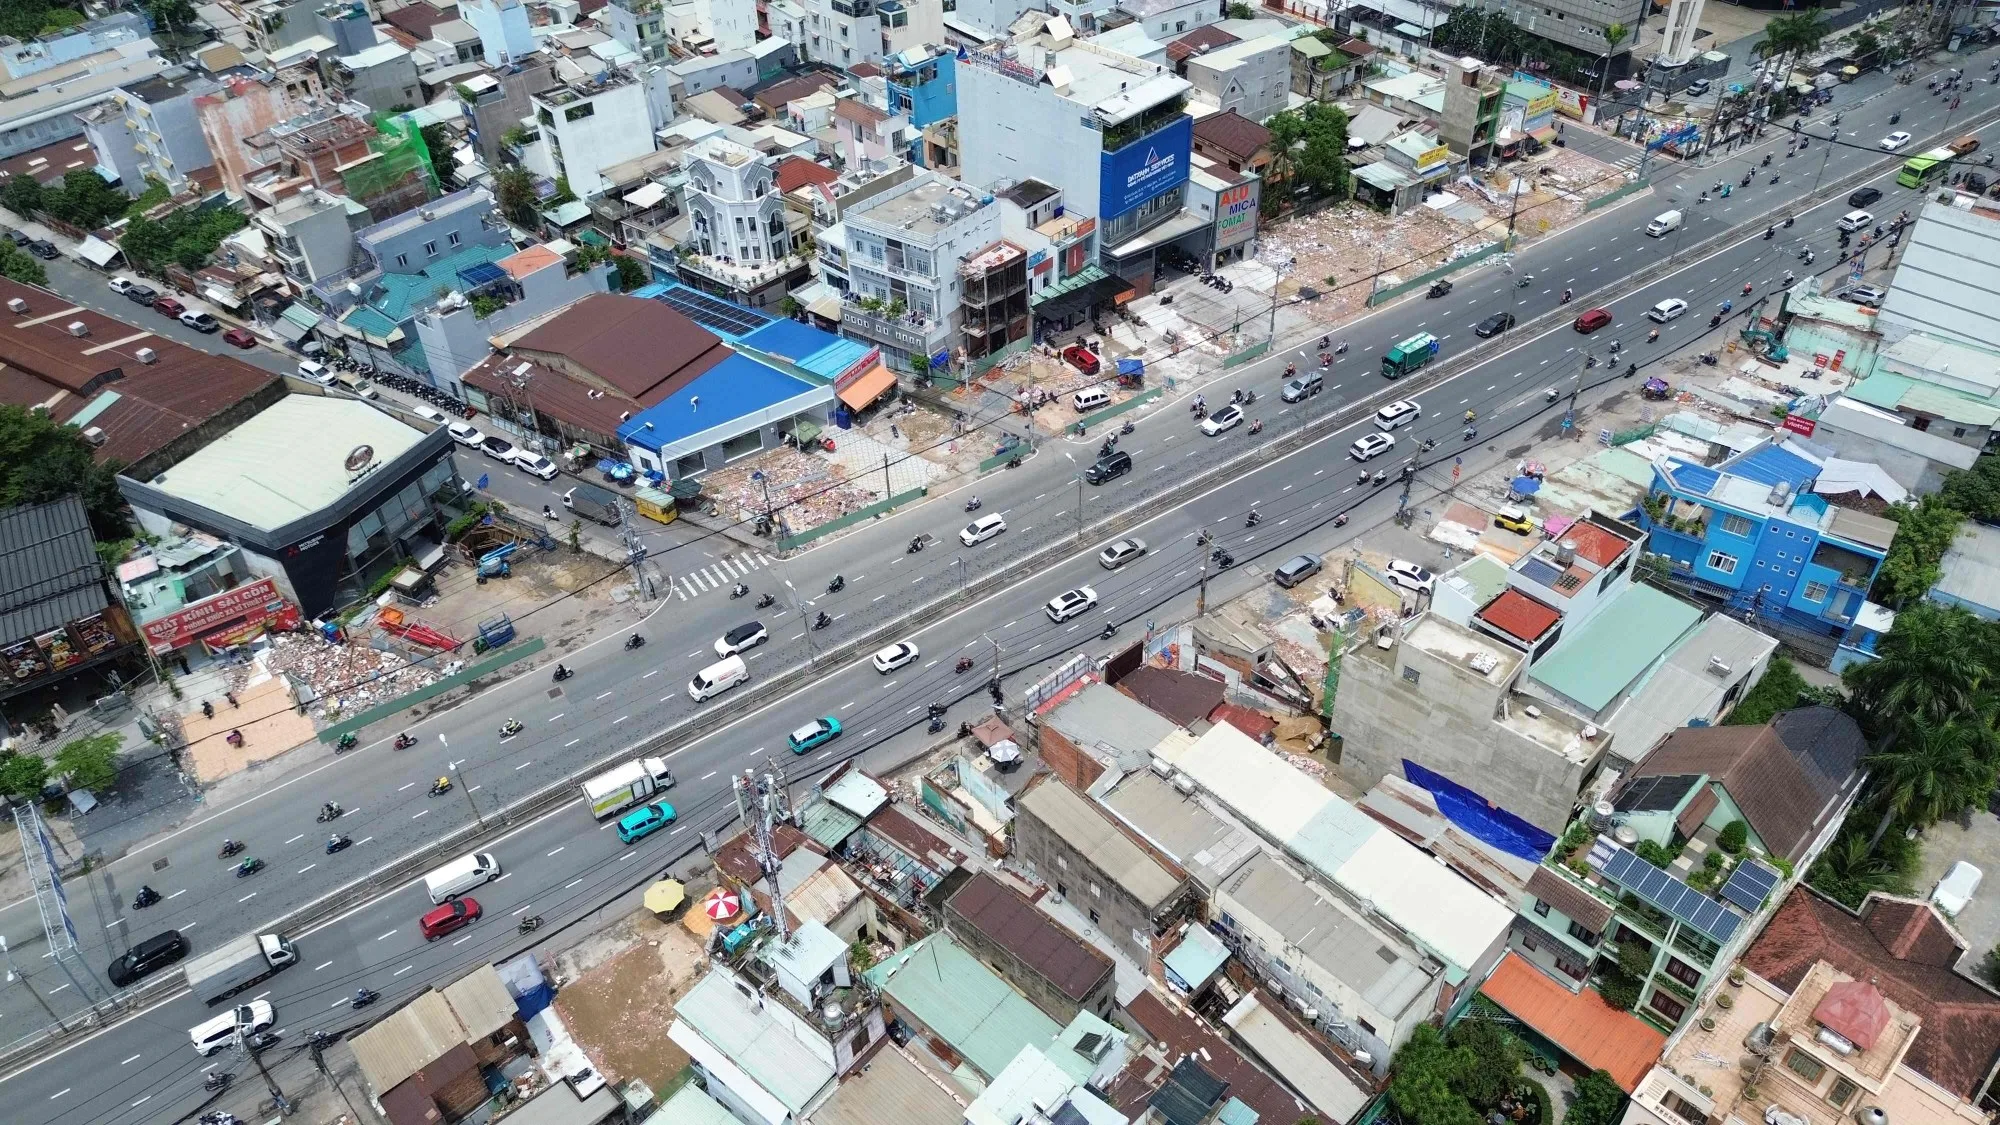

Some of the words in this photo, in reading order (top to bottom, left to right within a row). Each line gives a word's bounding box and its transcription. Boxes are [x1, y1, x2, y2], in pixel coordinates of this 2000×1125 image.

[1150, 154, 1175, 171] SERVICES
[1220, 184, 1249, 207] ALU
[1230, 198, 1256, 215] MICA
[1218, 213, 1245, 230] FOMAT
[300, 541, 320, 551] MOTORS
[264, 592, 277, 602] CAO
[150, 614, 179, 635] MẮT
[183, 604, 215, 622] KÍNH
[218, 594, 240, 609] SÀI
[242, 583, 270, 599] GÒN
